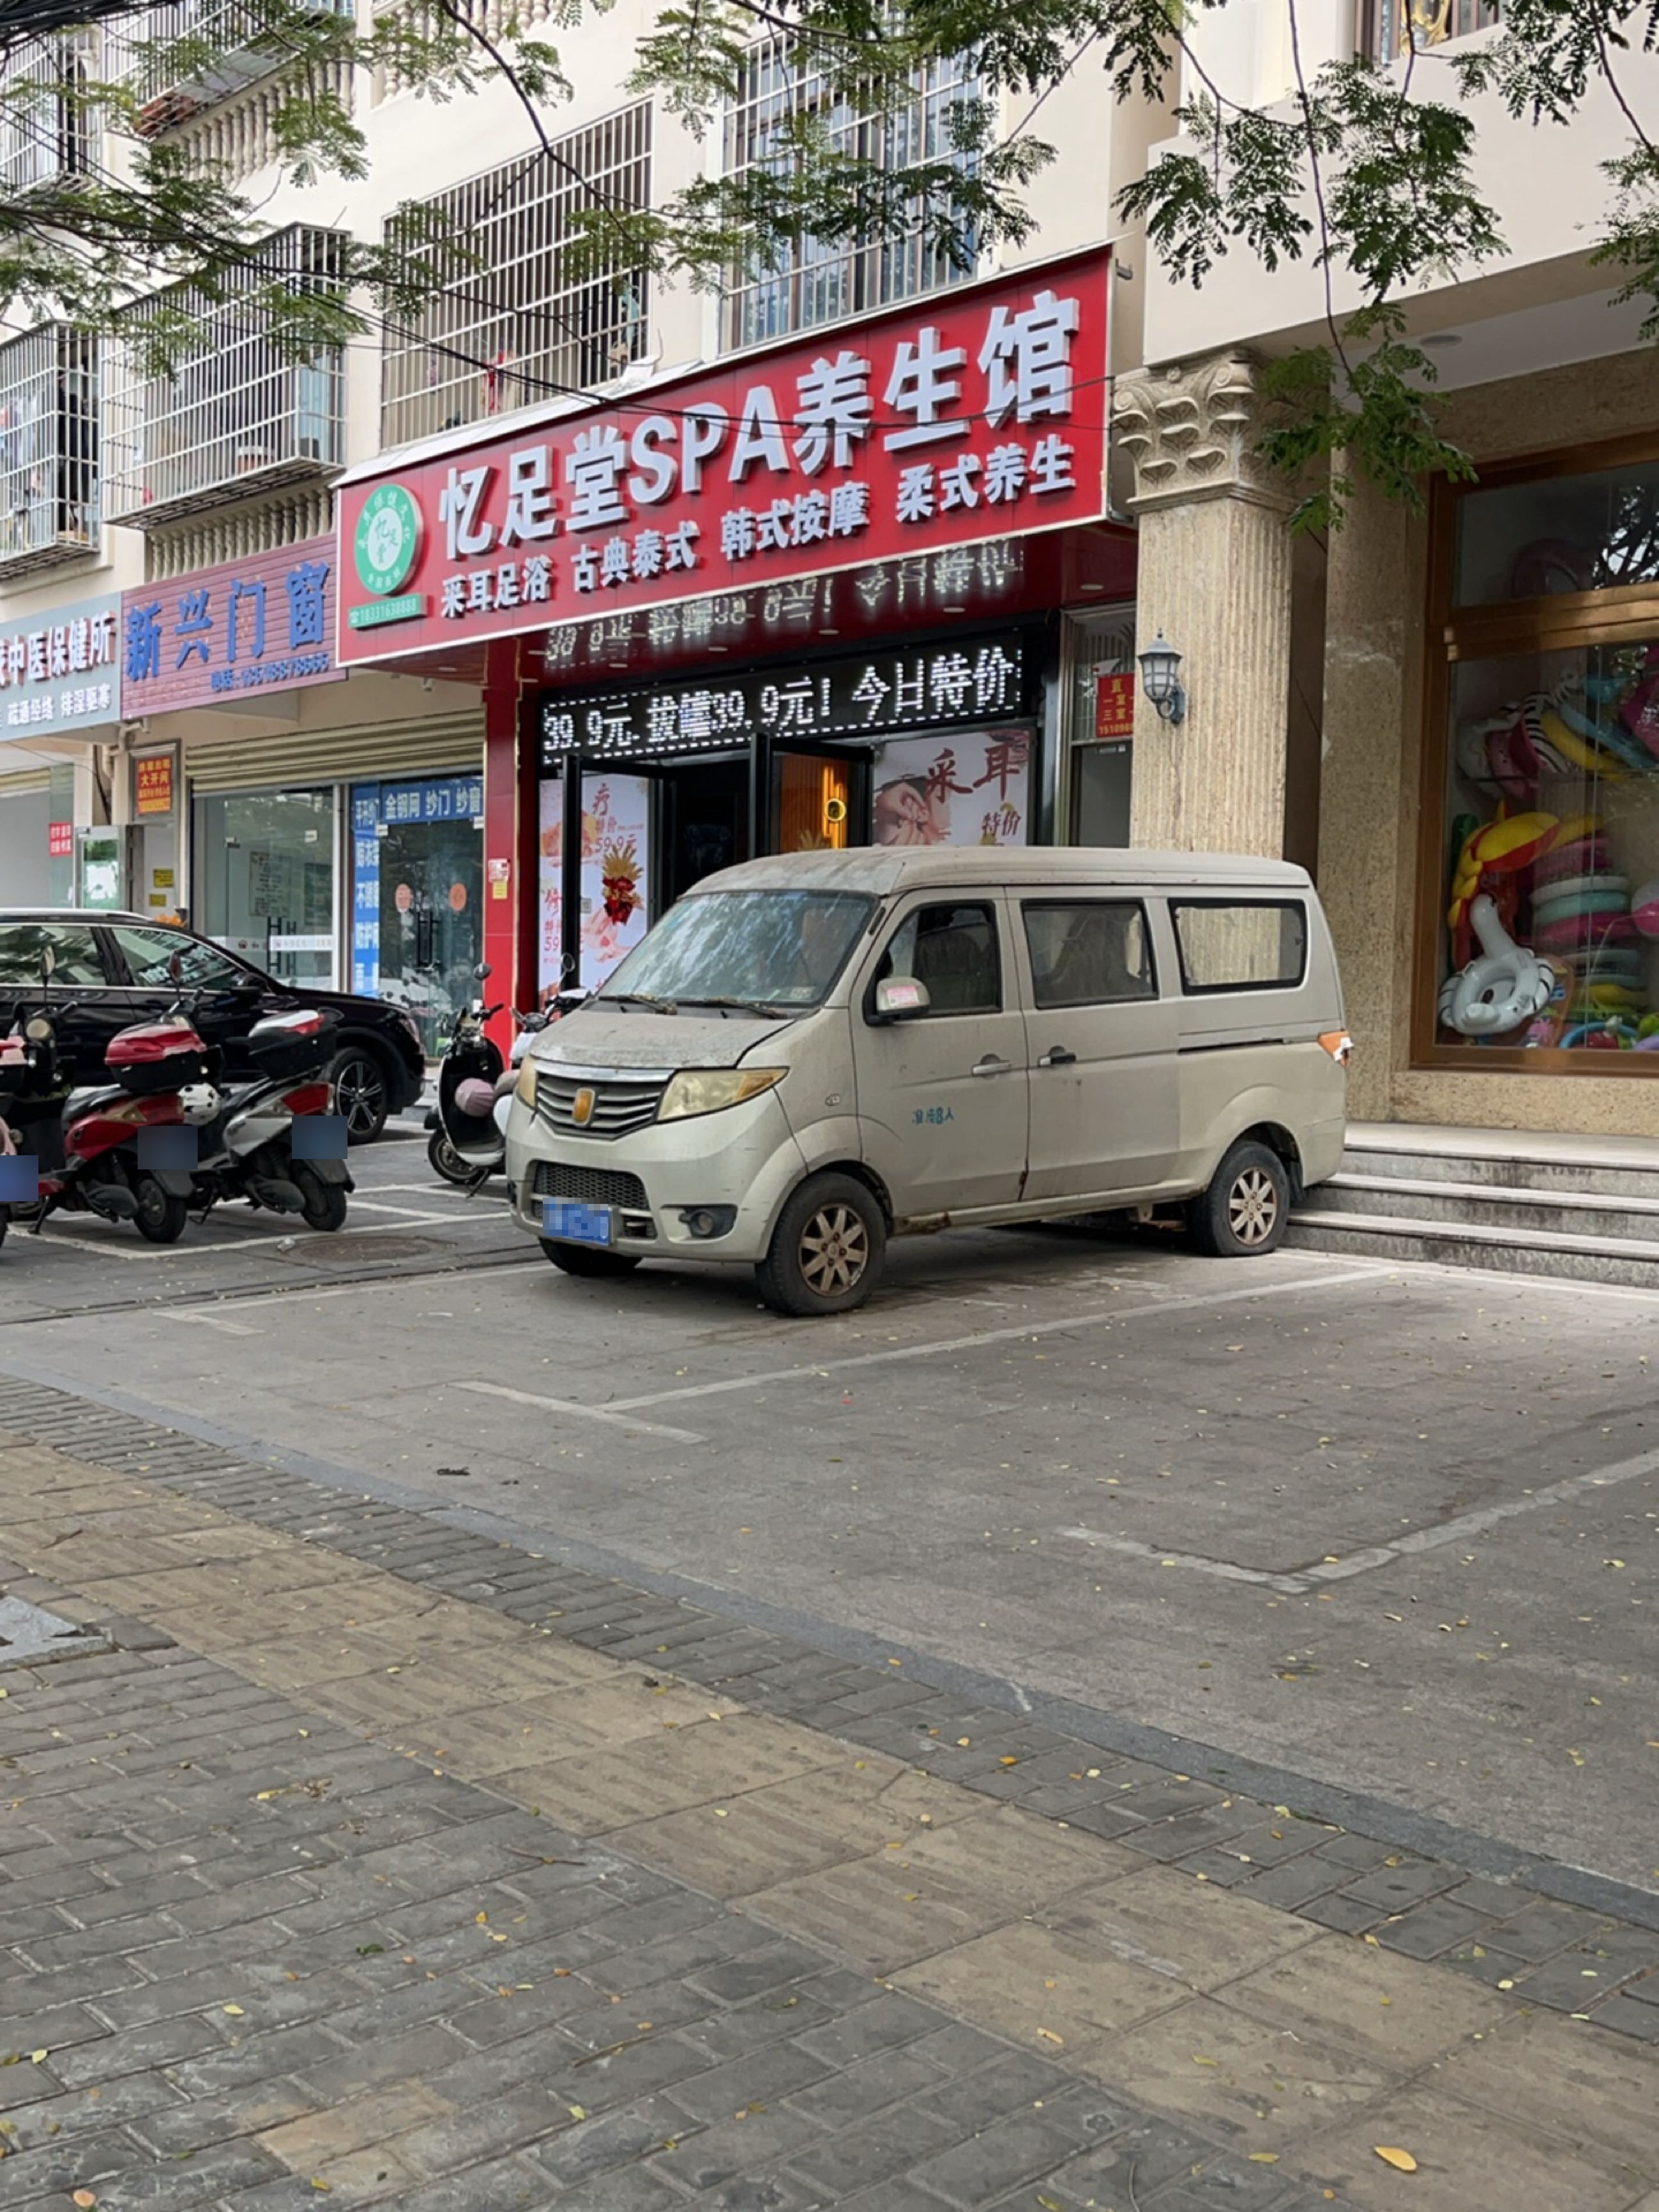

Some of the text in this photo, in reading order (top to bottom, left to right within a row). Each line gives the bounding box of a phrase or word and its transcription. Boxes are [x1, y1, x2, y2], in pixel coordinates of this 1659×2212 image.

[438, 289, 1080, 561] 忆足堂SPA养生馆
[440, 433, 1076, 619] 采耳足浴 古典泰式 韩式按摩 柔式养生
[125, 559, 331, 682] 新兴门窗
[926, 739, 1020, 804] 采耳
